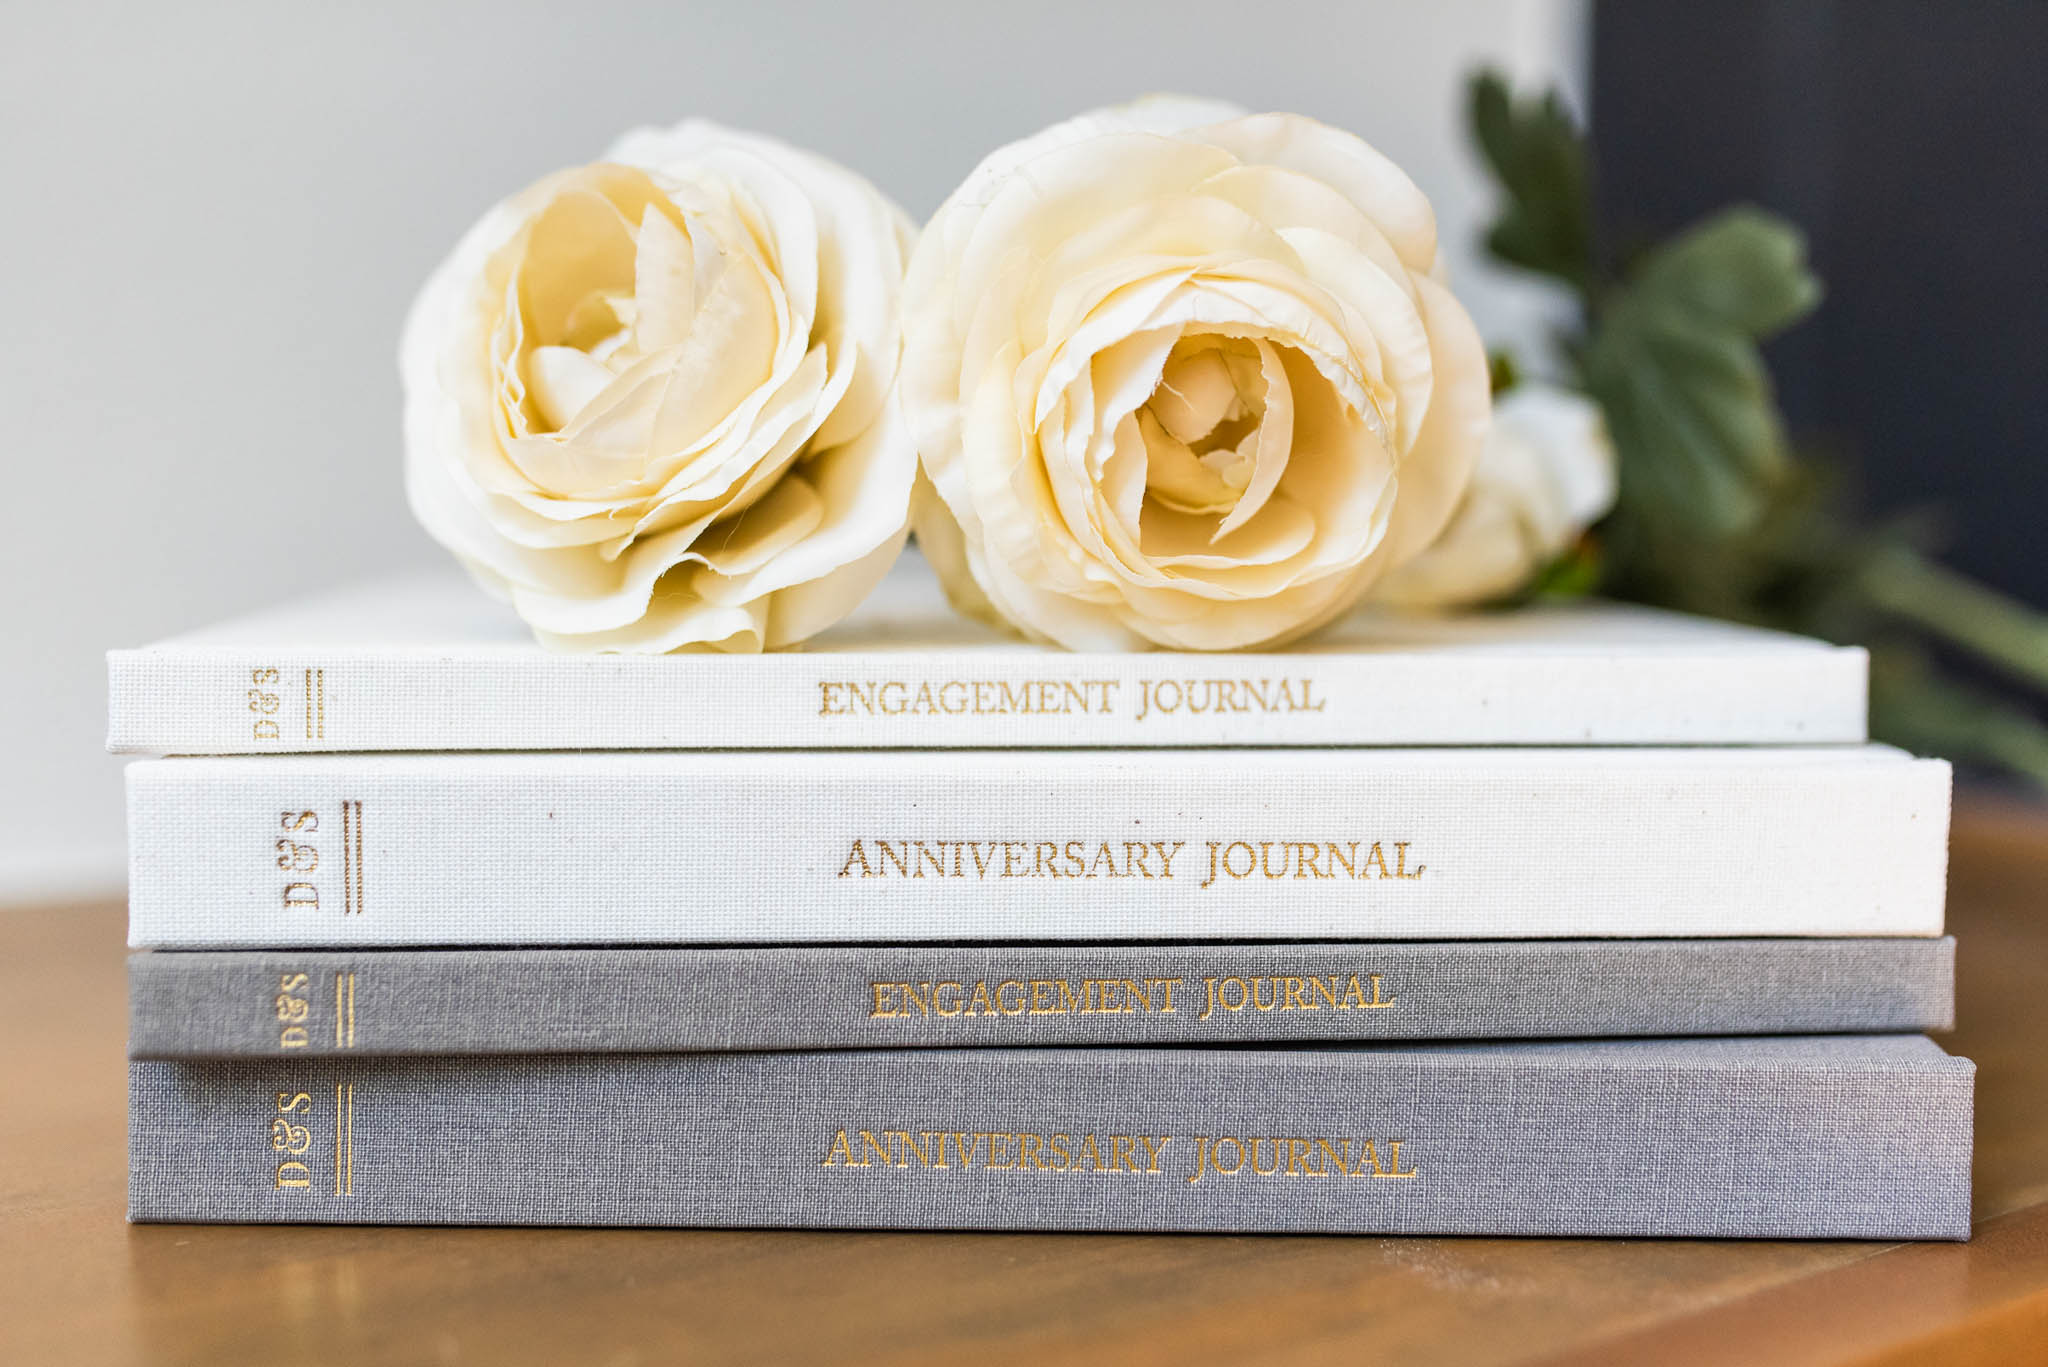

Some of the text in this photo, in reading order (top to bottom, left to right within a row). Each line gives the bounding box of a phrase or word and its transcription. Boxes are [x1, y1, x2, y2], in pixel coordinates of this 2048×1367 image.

[247, 668, 281, 740] D&S
[818, 679, 1326, 721] ENGAGEMENT JOURNAL
[276, 810, 319, 910] D&S
[839, 840, 1425, 889] ANNIVERSARY JOURNAL
[276, 972, 309, 1049] D&S
[871, 974, 1396, 1020] ENGAGEMENT JOURNAL
[272, 1091, 312, 1191] D&S
[823, 1129, 1418, 1183] ANNIVERSARY JOURNAL
